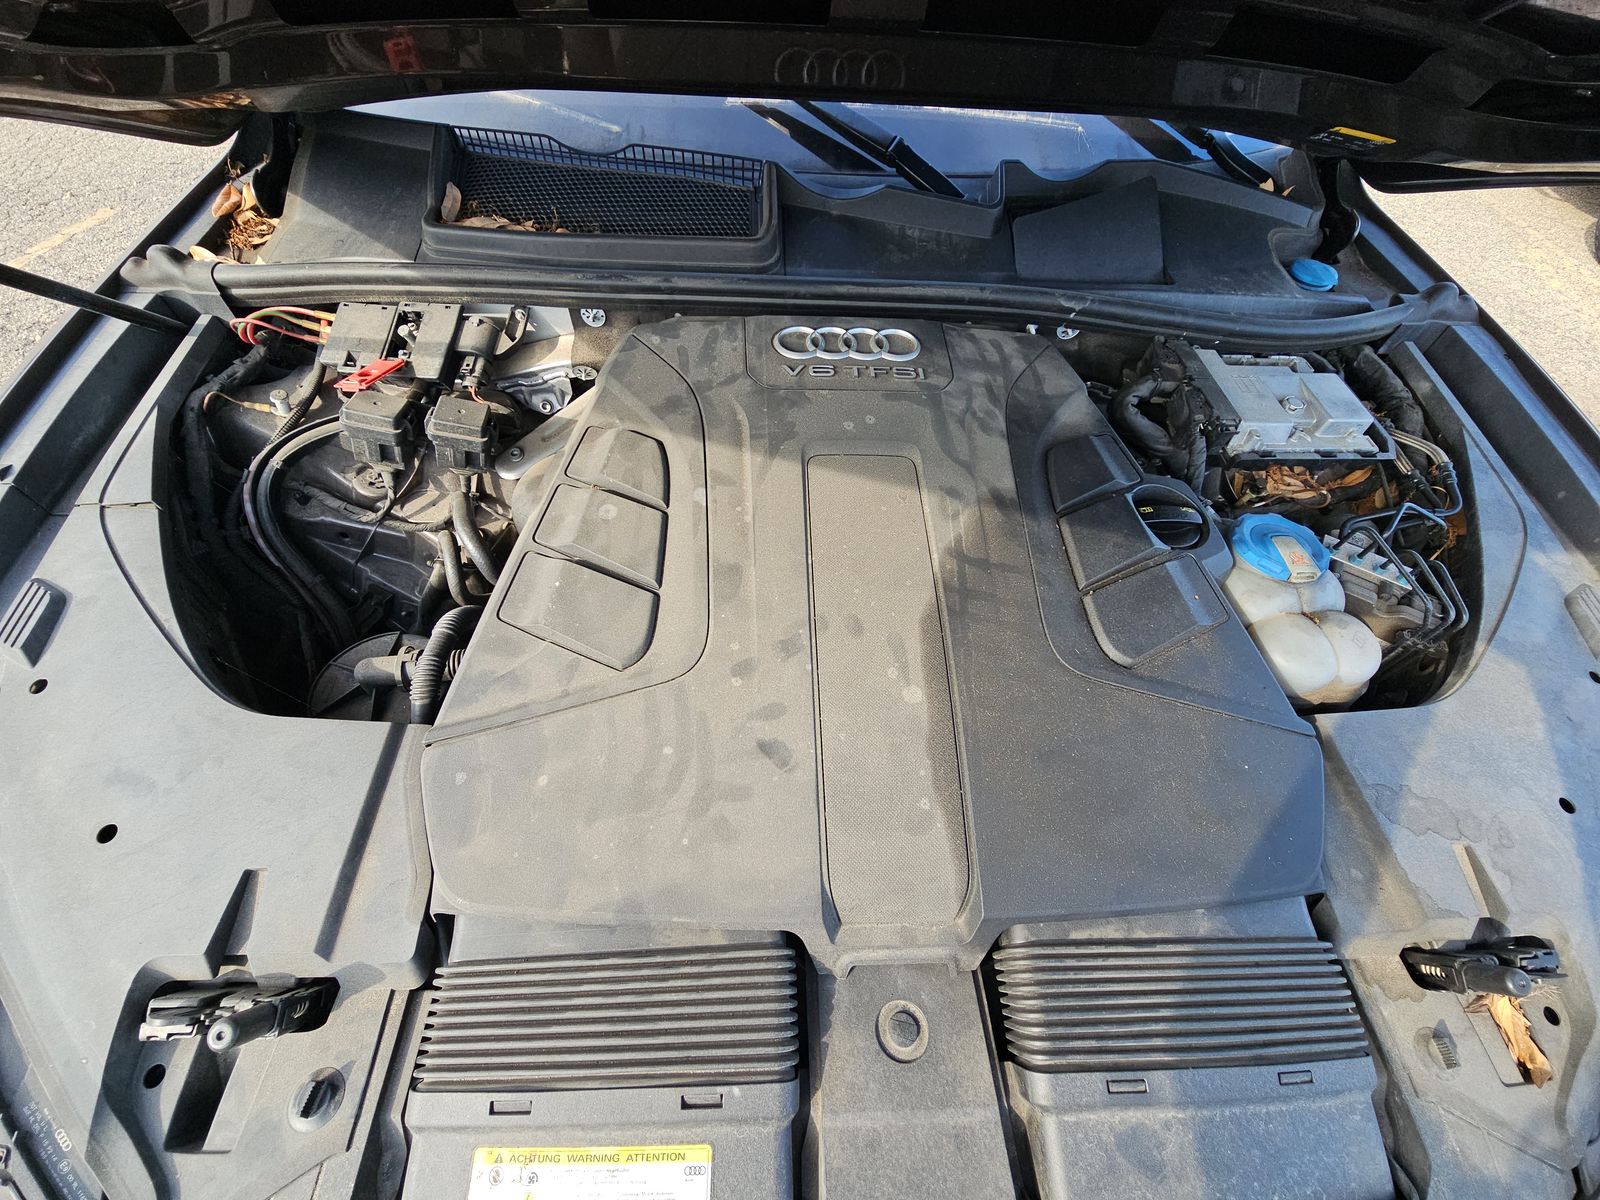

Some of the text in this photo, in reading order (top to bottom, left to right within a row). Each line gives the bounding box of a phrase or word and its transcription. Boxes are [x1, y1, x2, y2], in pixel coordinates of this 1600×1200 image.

[782, 364, 926, 381] V6 TFSI
[509, 1152, 686, 1163] ACHTUNG WARNING ATTENTION
